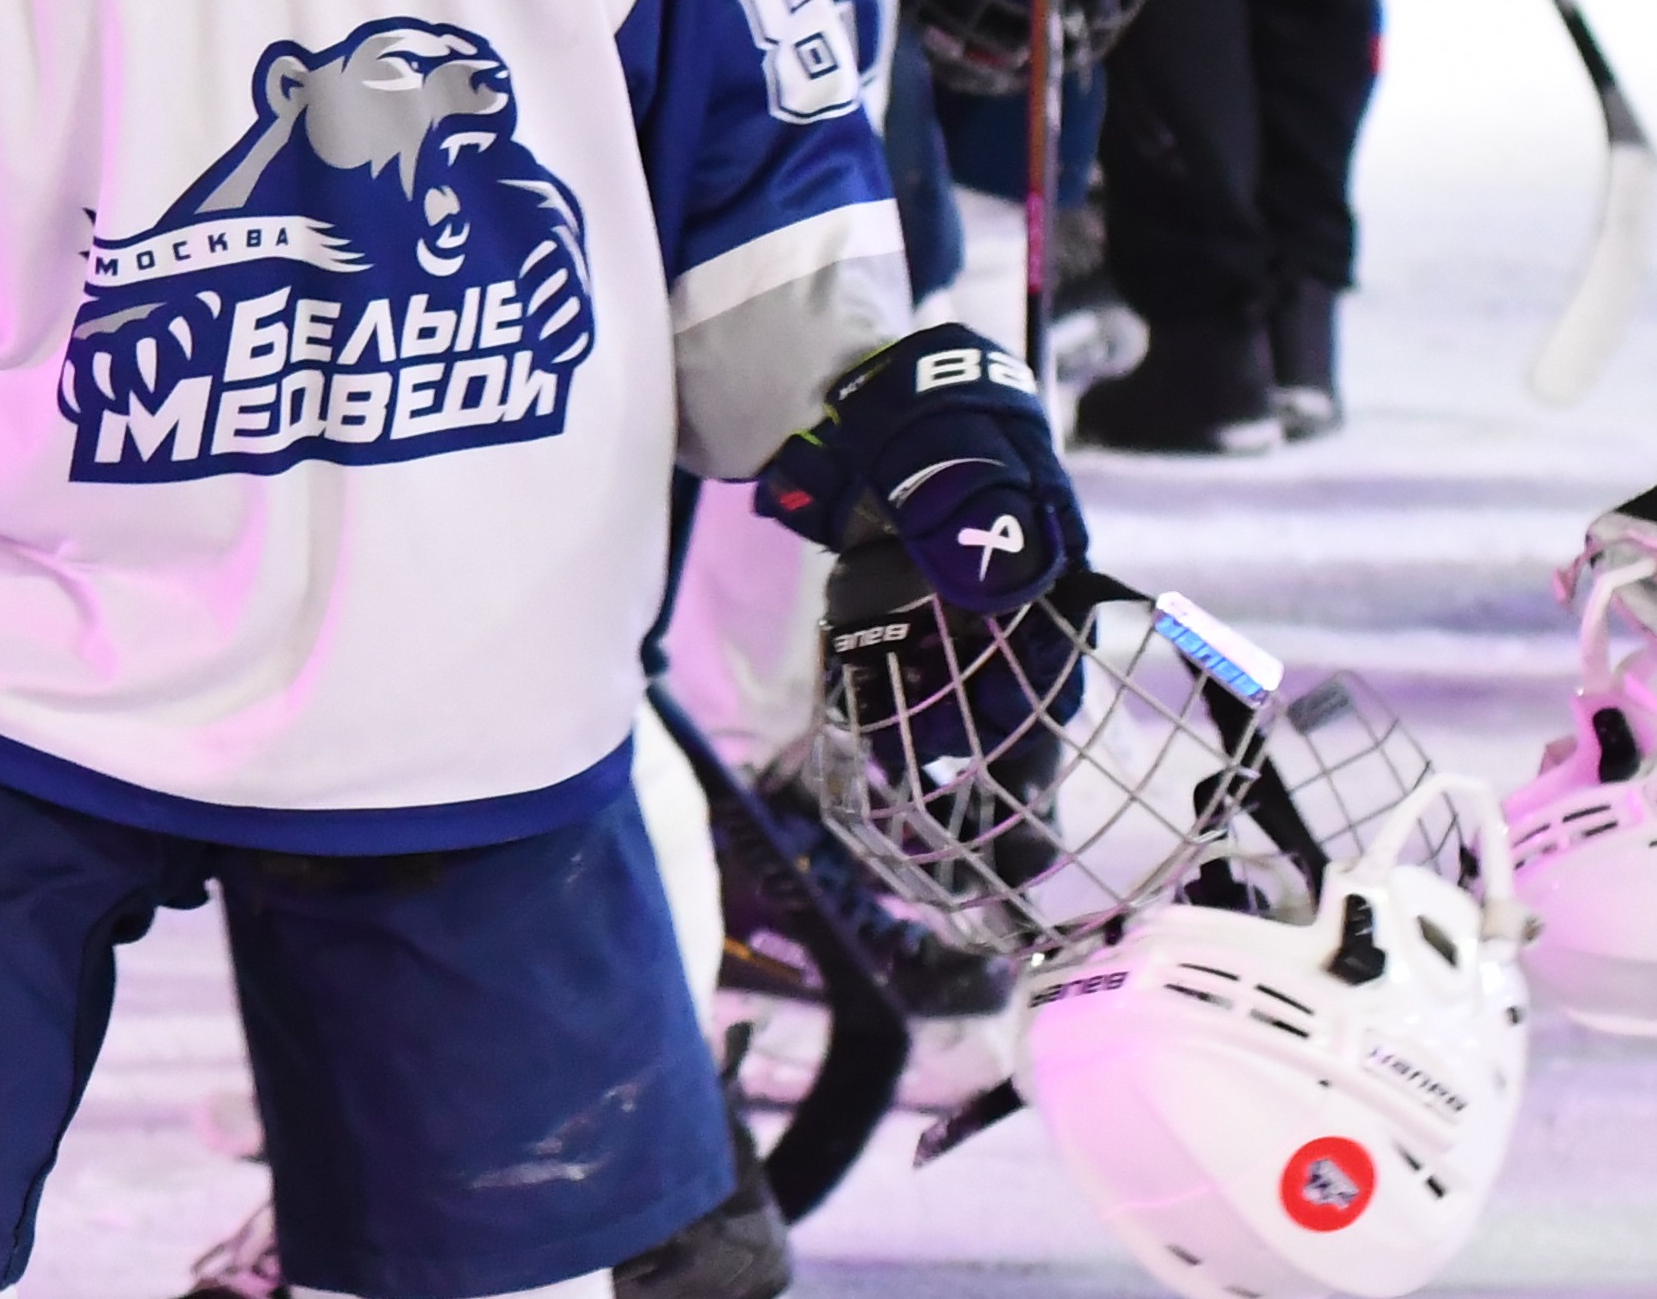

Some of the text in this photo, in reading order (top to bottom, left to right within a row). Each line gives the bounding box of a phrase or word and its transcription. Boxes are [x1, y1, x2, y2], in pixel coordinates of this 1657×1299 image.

[94, 227, 289, 277] МОСКВА
[222, 279, 525, 383] БЕЛЫЕ
[93, 349, 559, 464] МЕДВЕДИ
